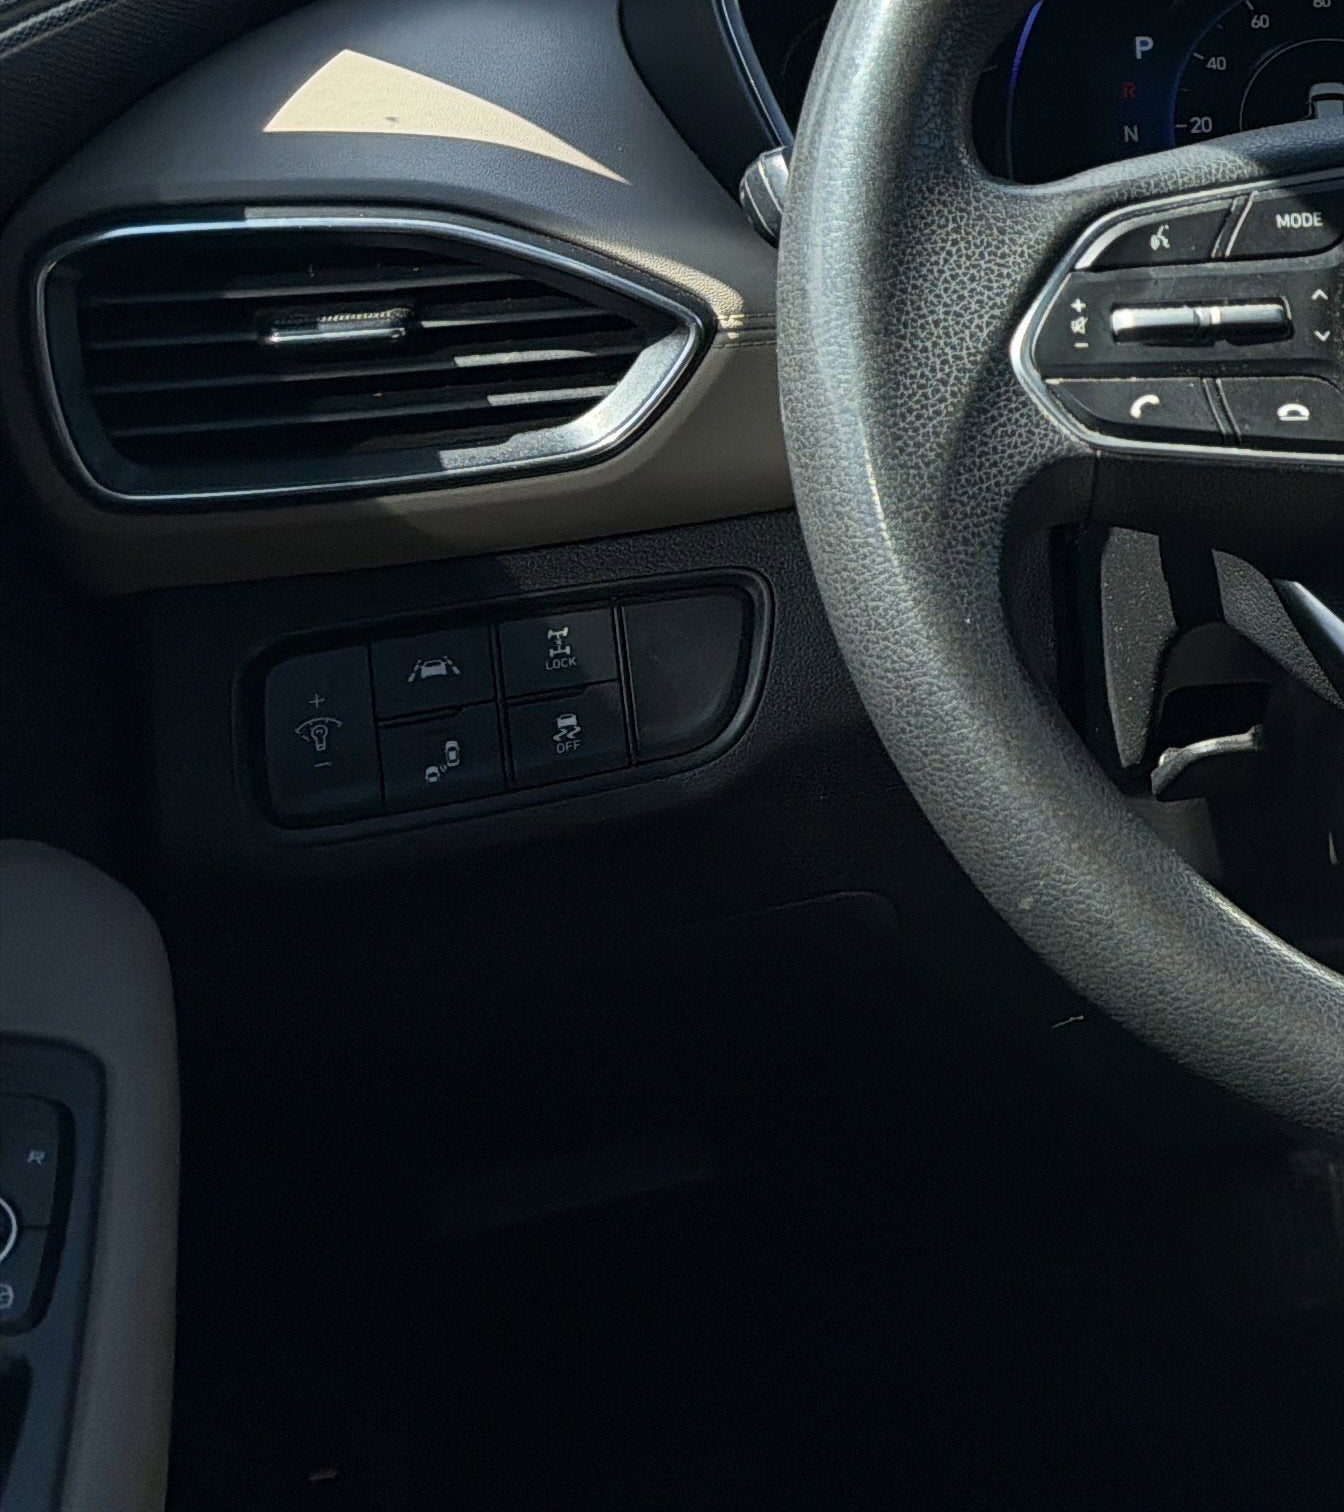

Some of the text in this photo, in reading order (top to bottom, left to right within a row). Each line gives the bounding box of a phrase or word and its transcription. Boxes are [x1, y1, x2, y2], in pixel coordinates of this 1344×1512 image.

[1251, 14, 1270, 29] 60
[1135, 36, 1153, 60] P
[1206, 56, 1226, 71] 40
[1121, 82, 1136, 100] R
[1124, 125, 1138, 143] N
[1190, 117, 1212, 134] 20
[1275, 212, 1323, 229] MODE
[545, 656, 576, 670] LOCK
[556, 740, 581, 753] OFF
